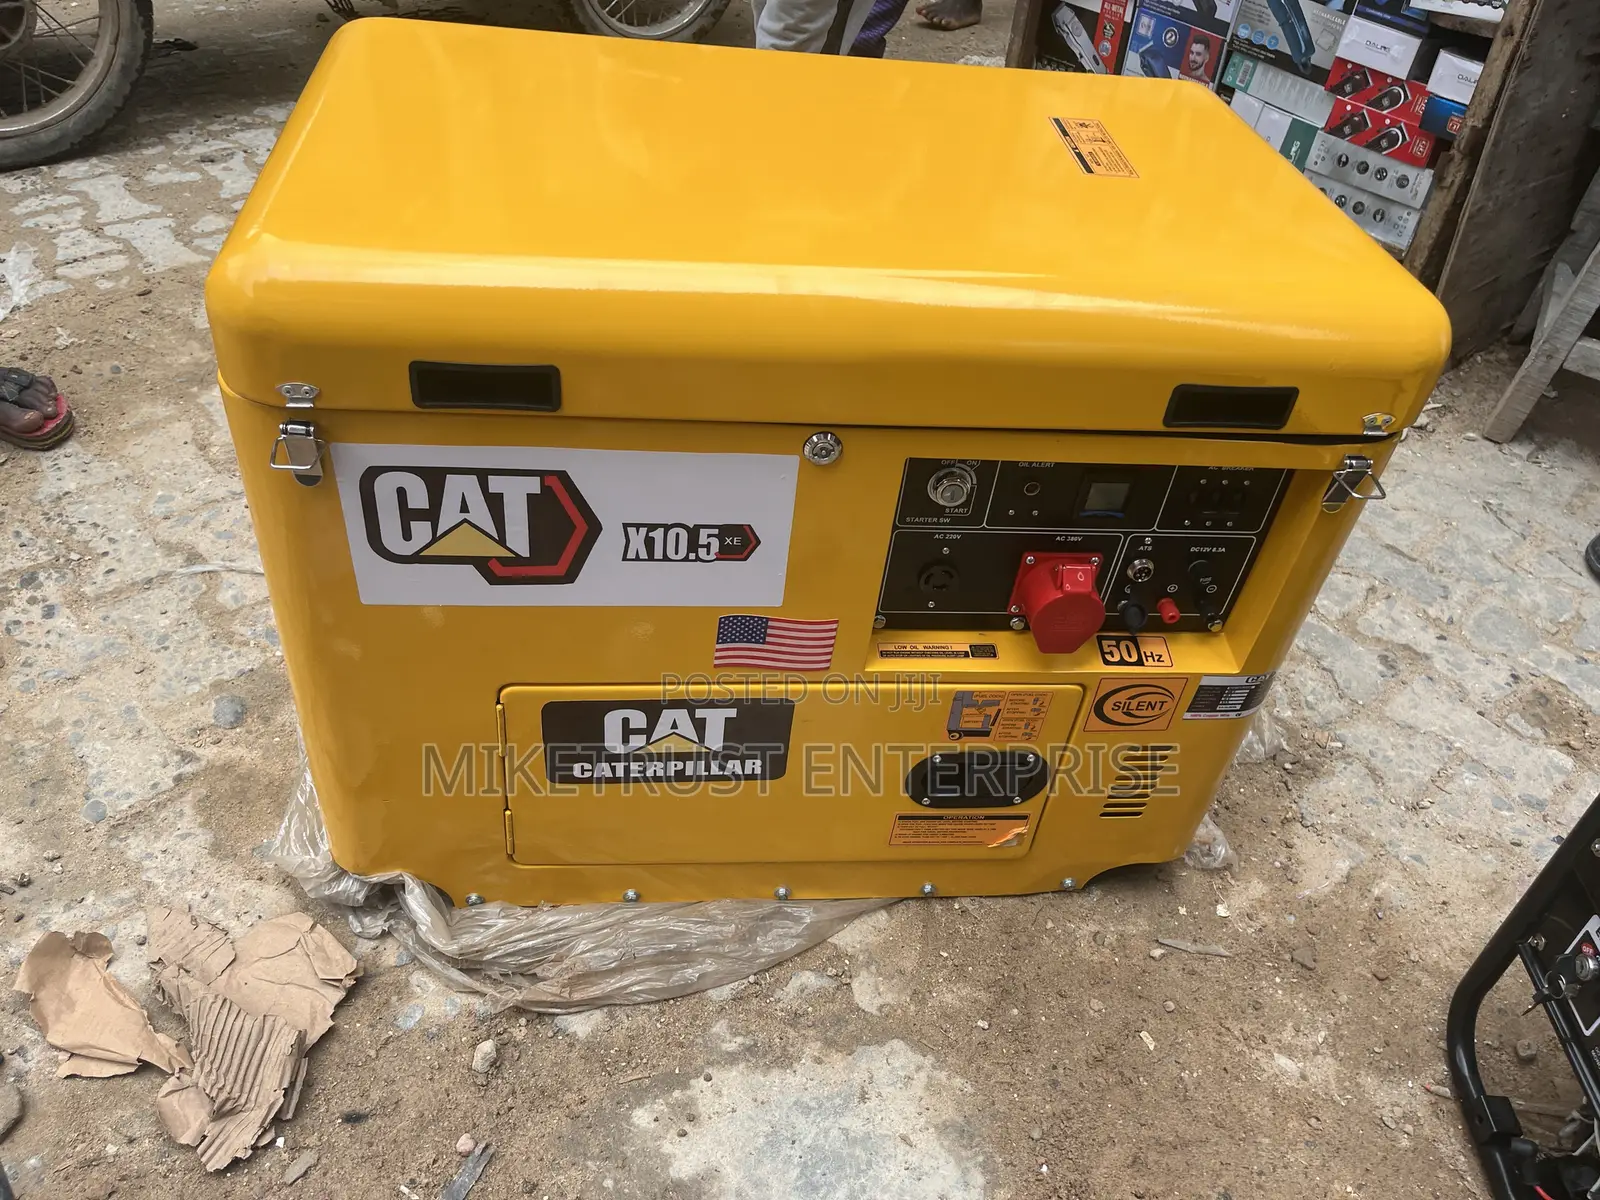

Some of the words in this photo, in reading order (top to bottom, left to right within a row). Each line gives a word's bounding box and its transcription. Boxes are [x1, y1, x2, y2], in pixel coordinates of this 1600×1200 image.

[373, 471, 541, 559] CAT
[626, 526, 719, 561] X10.5
[723, 537, 743, 547] XE
[1101, 639, 1139, 664] 50
[1143, 650, 1165, 664] Hz
[1111, 700, 1169, 712] SILENT
[603, 707, 738, 754] CAT
[572, 758, 763, 779] CATERPILLAR
